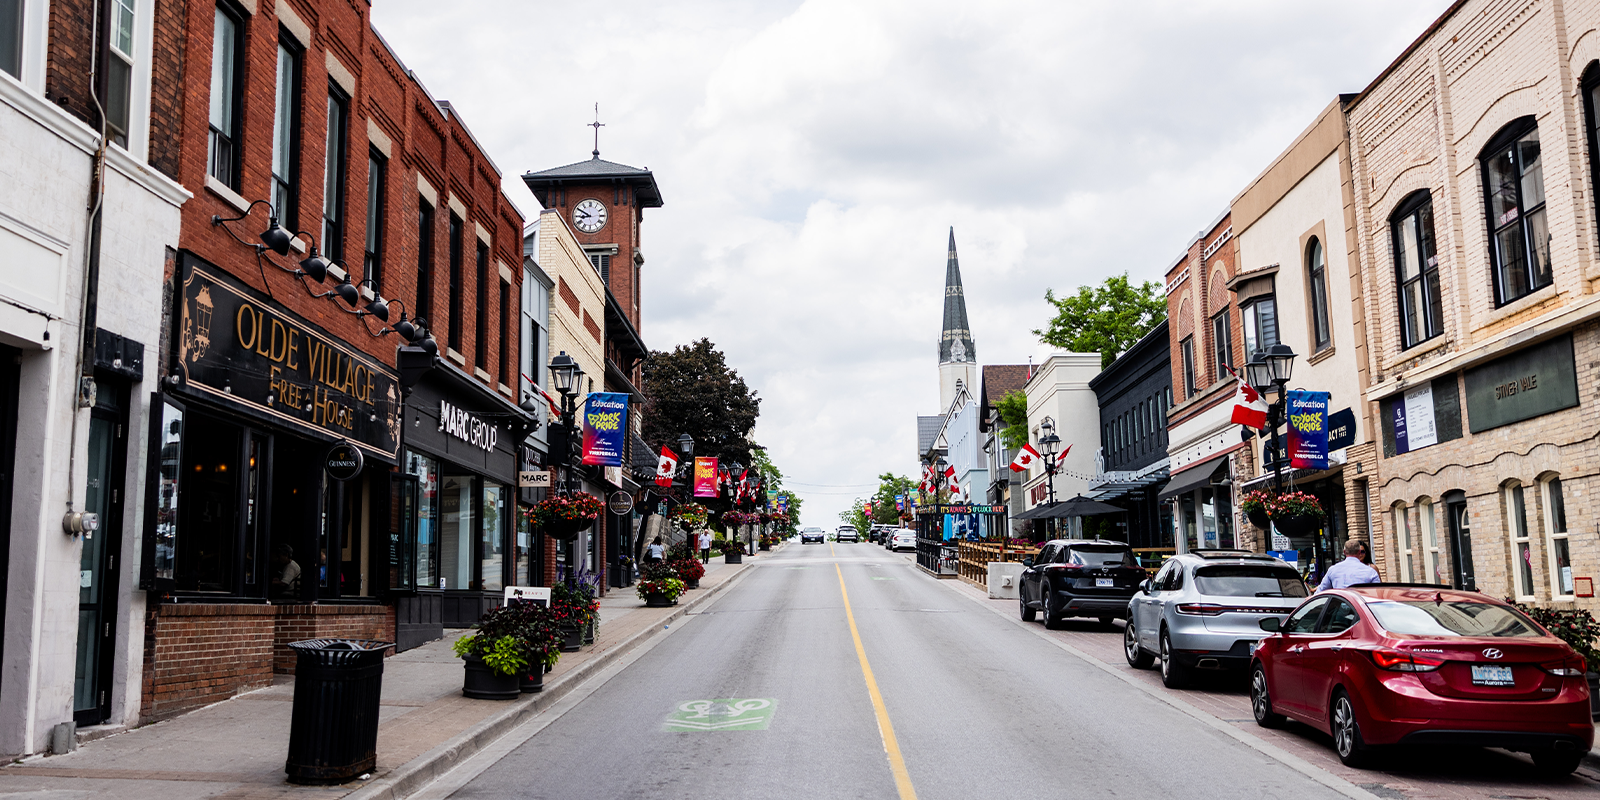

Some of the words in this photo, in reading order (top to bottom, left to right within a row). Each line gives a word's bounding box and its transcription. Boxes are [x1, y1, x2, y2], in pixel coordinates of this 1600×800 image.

[236, 303, 299, 371] OLDE
[307, 335, 376, 406] VILLAGE
[1495, 380, 1519, 400] STIVER
[312, 384, 354, 431] HOUSE
[591, 400, 625, 409] Education
[1292, 399, 1325, 409] Education
[598, 411, 621, 423] YORK
[1300, 411, 1323, 423] YORK
[440, 399, 470, 442] MARC
[470, 416, 498, 453] GROUP
[595, 421, 619, 431] PRIDE
[1298, 422, 1322, 433] PRIDE
[328, 459, 356, 468] GUINNESS
[521, 474, 548, 482] MARC
[967, 505, 972, 513] 5
